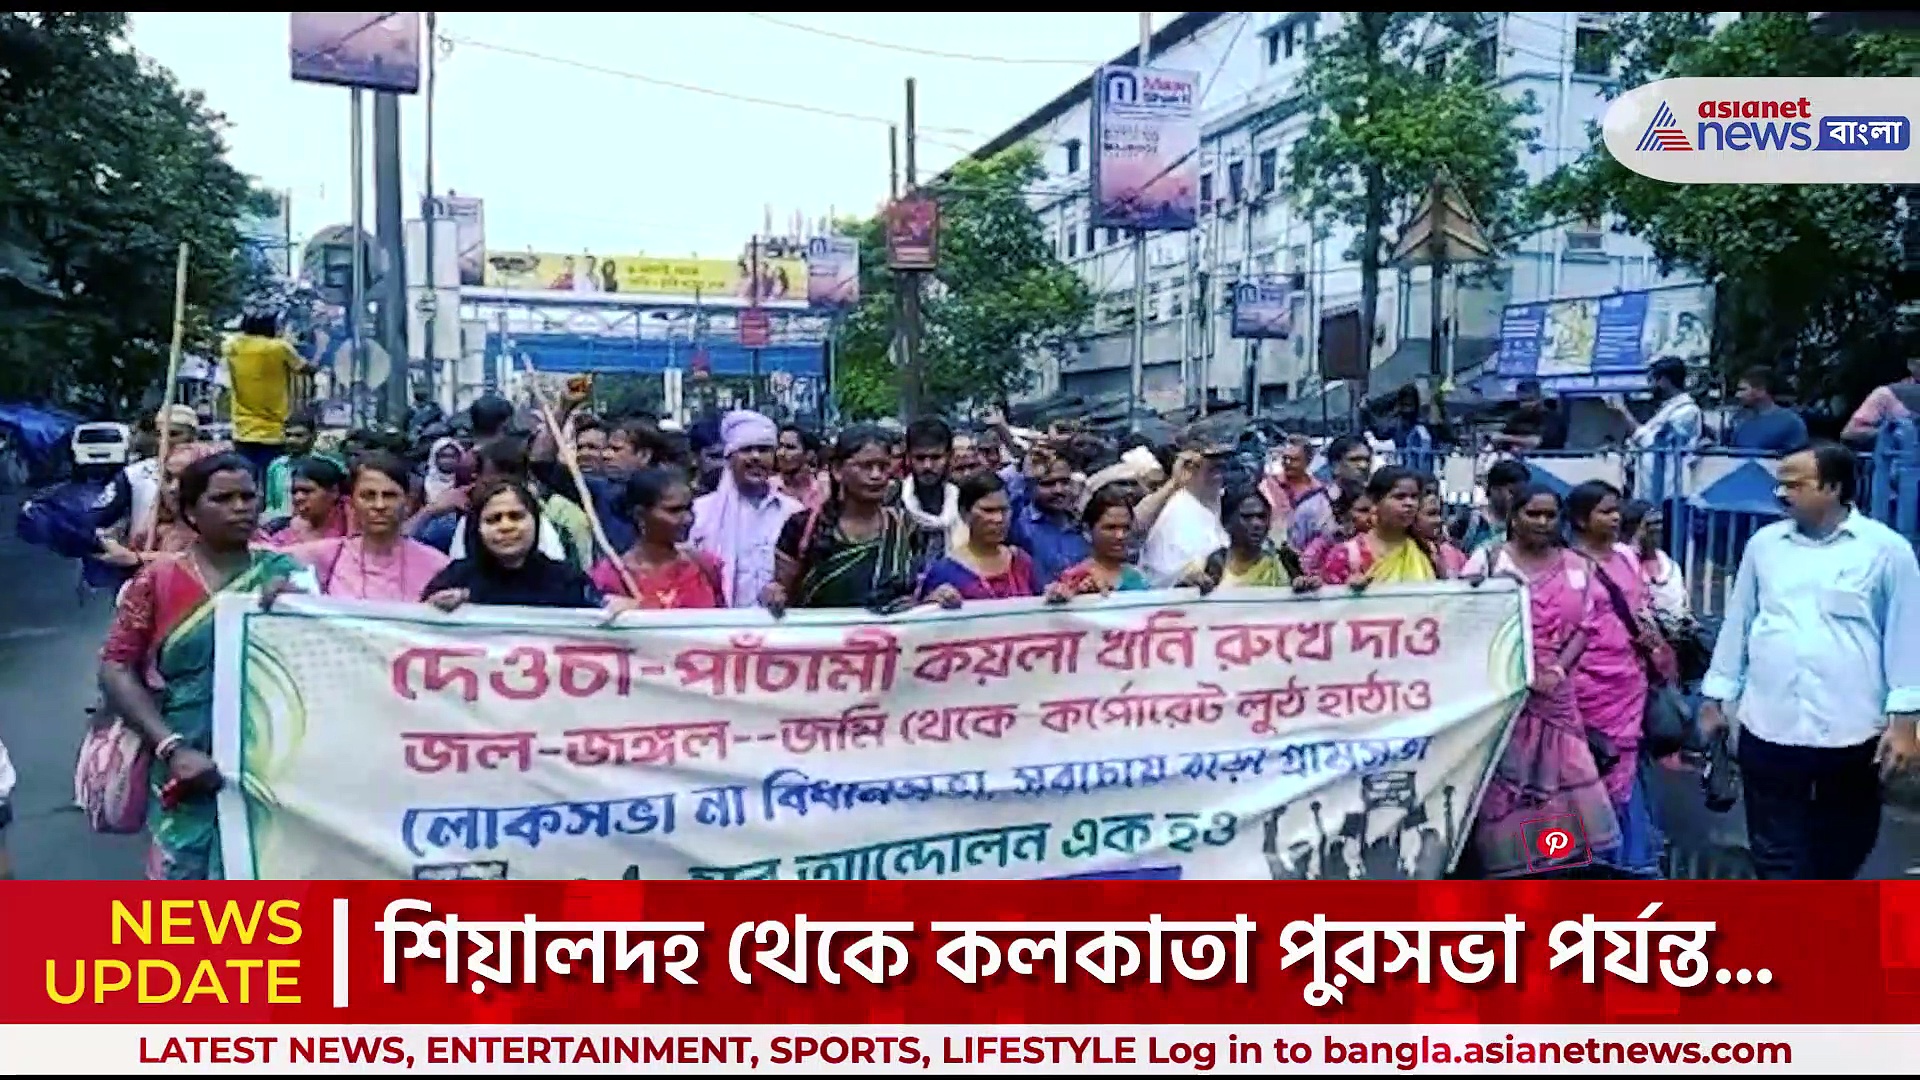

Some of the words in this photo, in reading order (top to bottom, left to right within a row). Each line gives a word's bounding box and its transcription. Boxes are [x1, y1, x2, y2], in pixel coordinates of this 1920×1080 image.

[391, 629, 902, 702] দেওচা-পাঁচামী
[914, 630, 1088, 688] কয়লা
[1096, 611, 1198, 671] খনি
[1211, 622, 1334, 673] রুখে
[1346, 616, 1442, 661] দাও
[899, 700, 1019, 745] থেকে
[1039, 681, 1226, 734] কর্পোরেট
[1236, 675, 1309, 736] লুঠ
[1316, 670, 1434, 720] হাঠাও
[402, 789, 677, 859] লোকসভা
[694, 785, 748, 828] না
[1061, 811, 1154, 858] এক
[1166, 811, 1240, 853] হও
